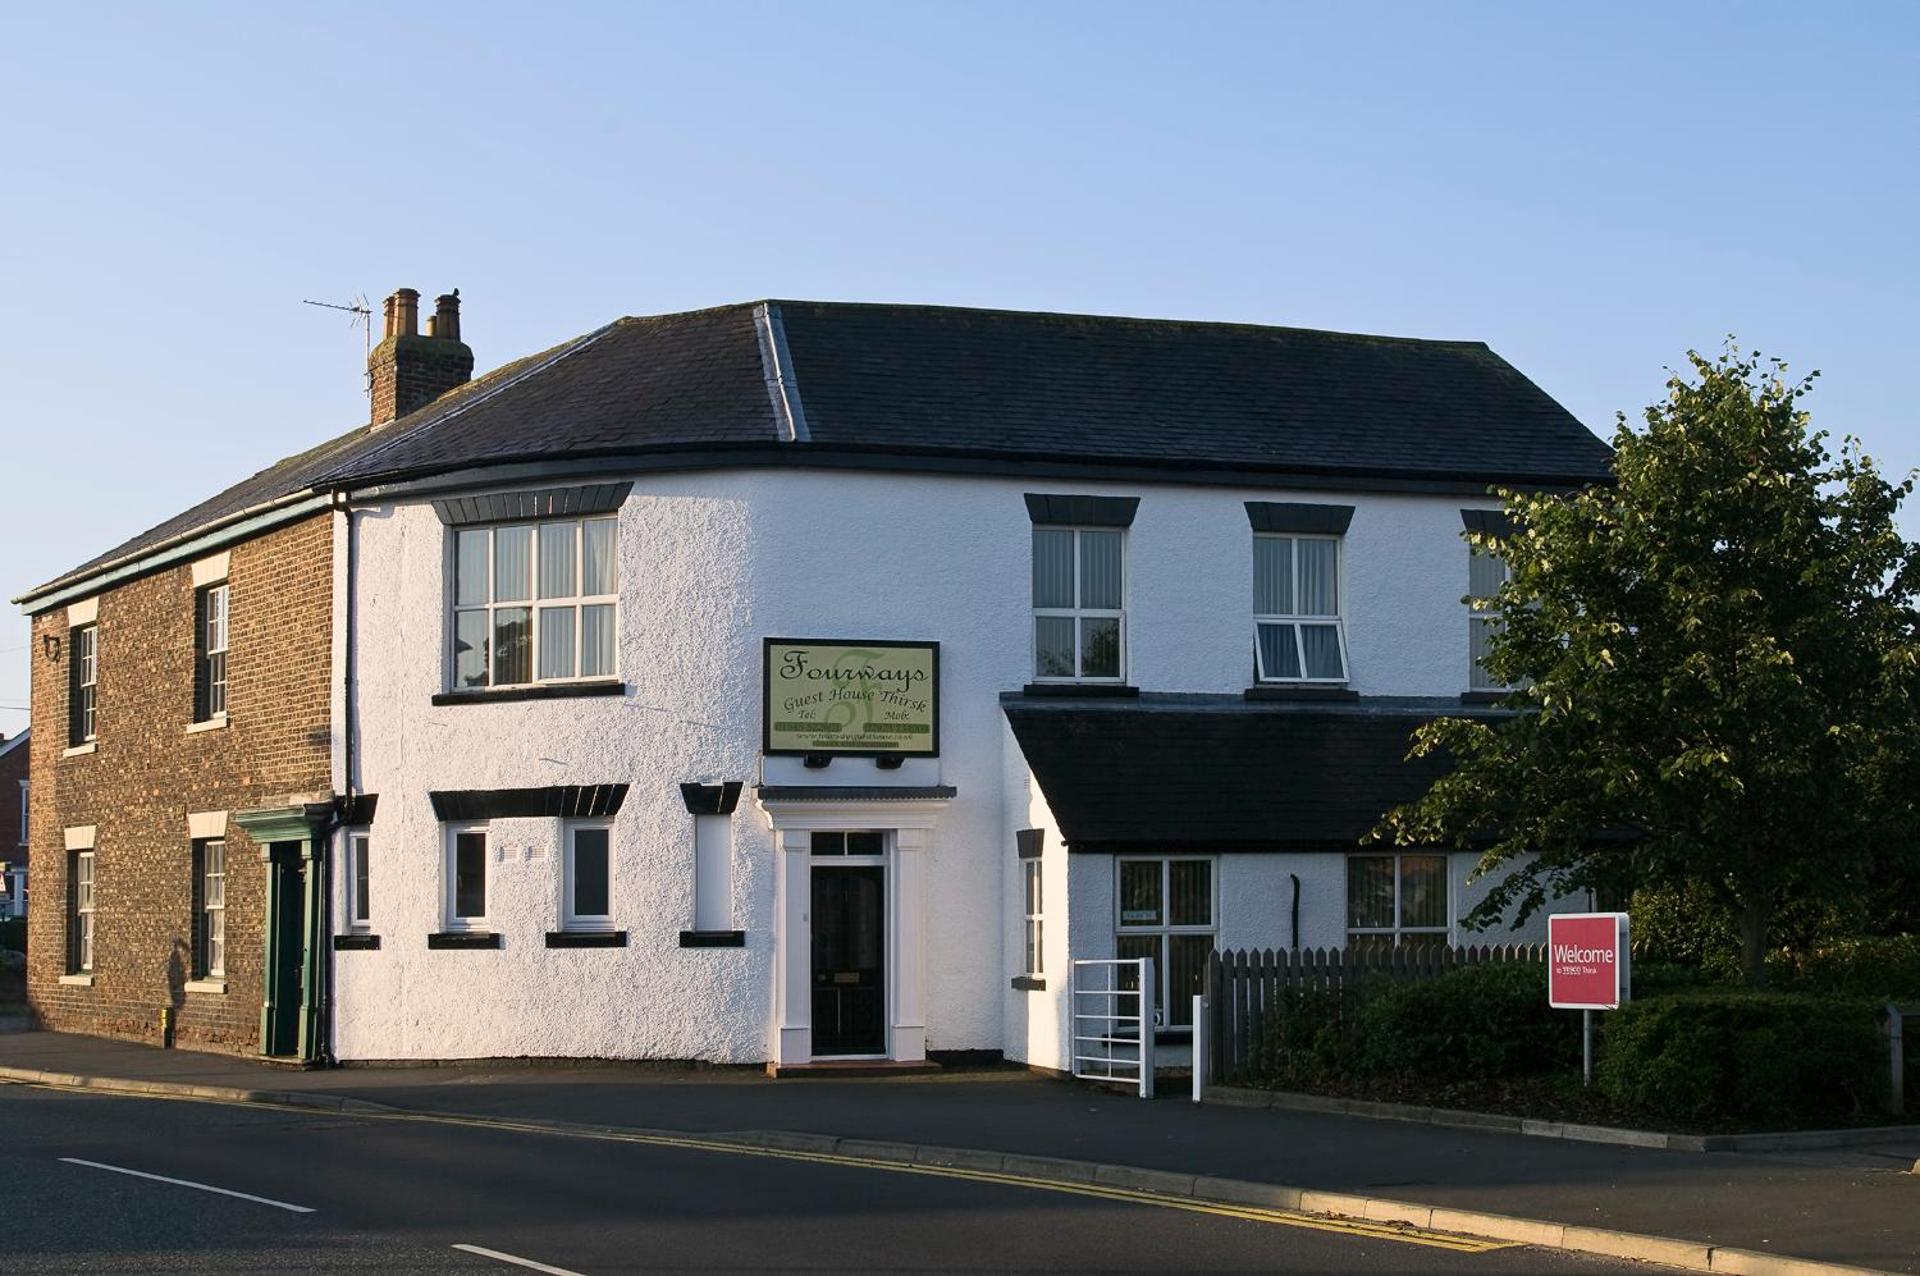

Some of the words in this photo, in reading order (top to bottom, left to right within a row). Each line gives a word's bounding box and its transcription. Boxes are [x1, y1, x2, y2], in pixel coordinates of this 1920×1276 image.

[780, 650, 929, 692] Fourways
[784, 691, 824, 713] Guest
[829, 687, 875, 701] House
[880, 690, 927, 713] Thirsk
[1554, 944, 1614, 963] Welcome
